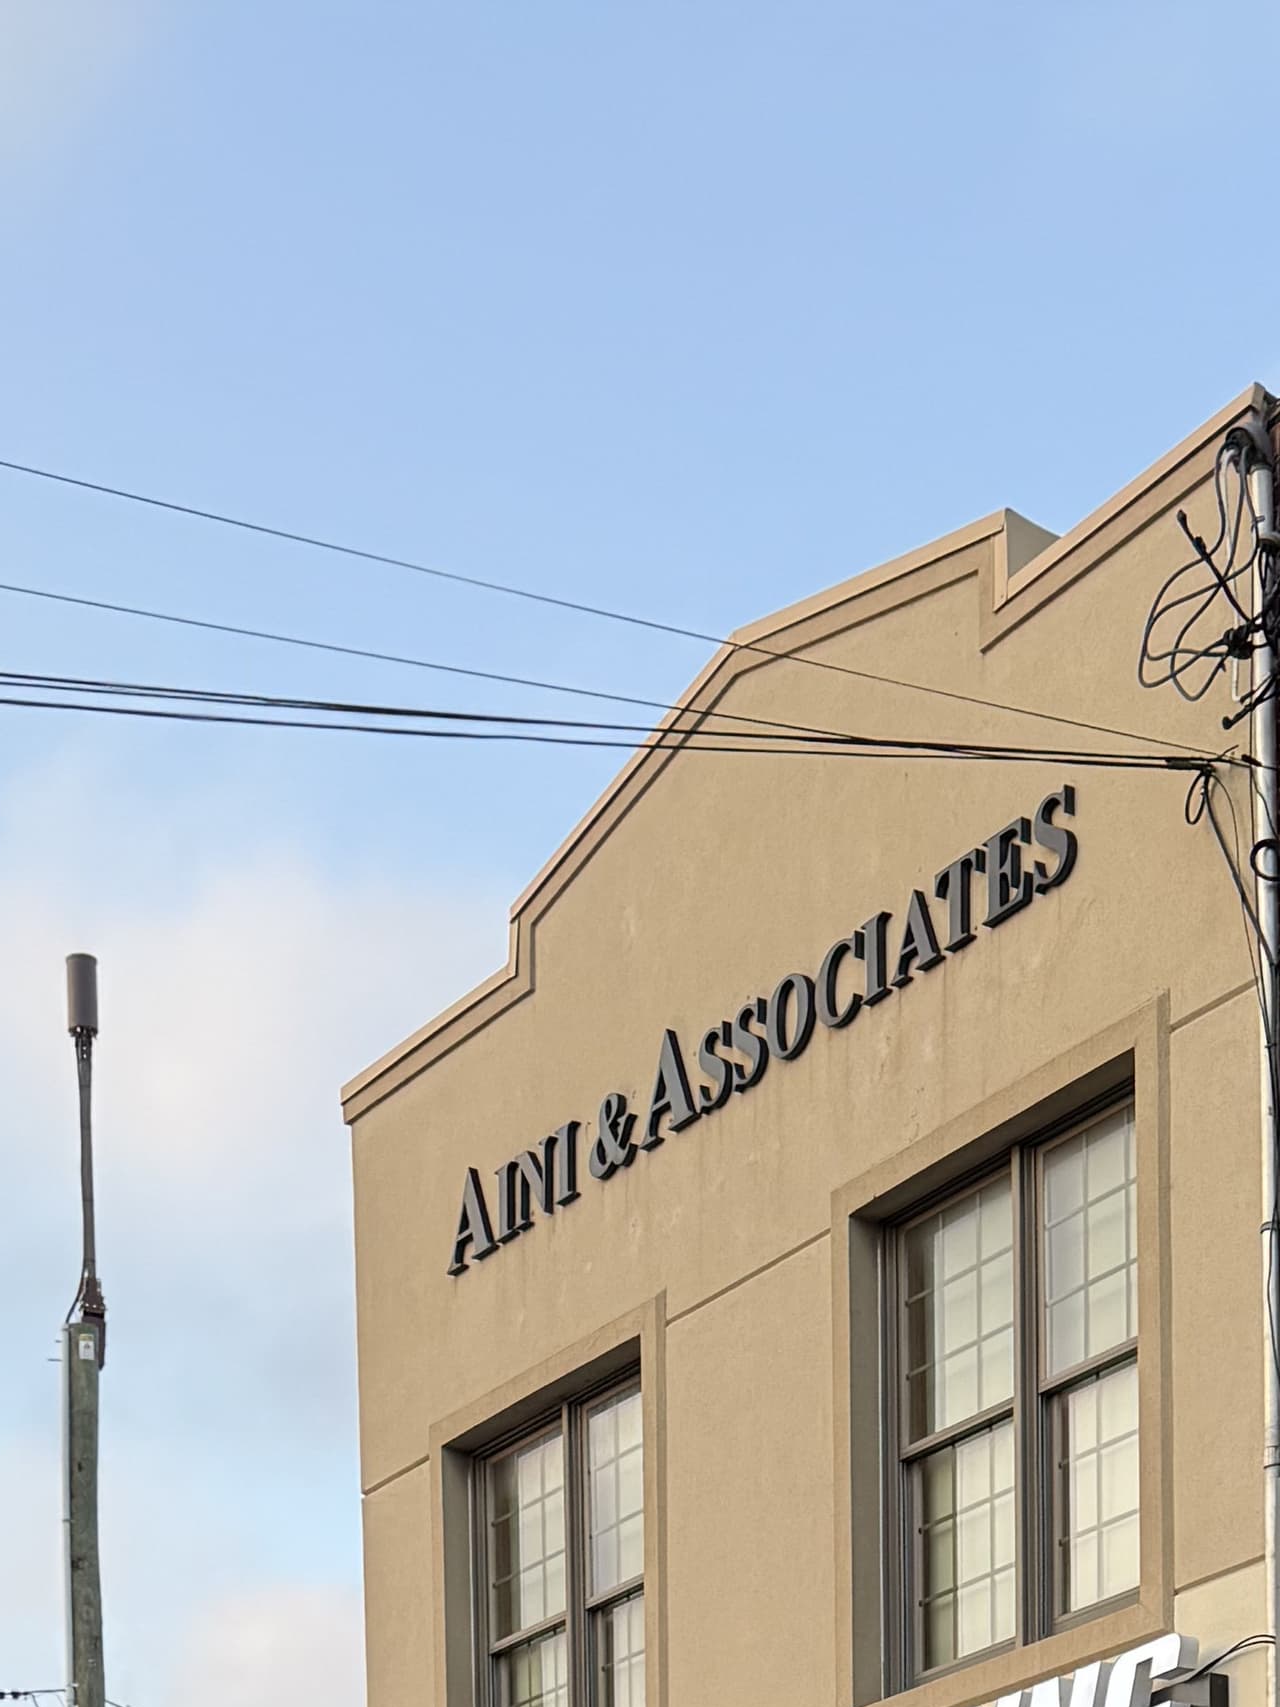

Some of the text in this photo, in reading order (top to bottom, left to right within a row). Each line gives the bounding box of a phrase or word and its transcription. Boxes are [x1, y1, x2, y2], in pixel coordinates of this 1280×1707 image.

[446, 784, 1077, 1277] AINI & ASSOCIATES
